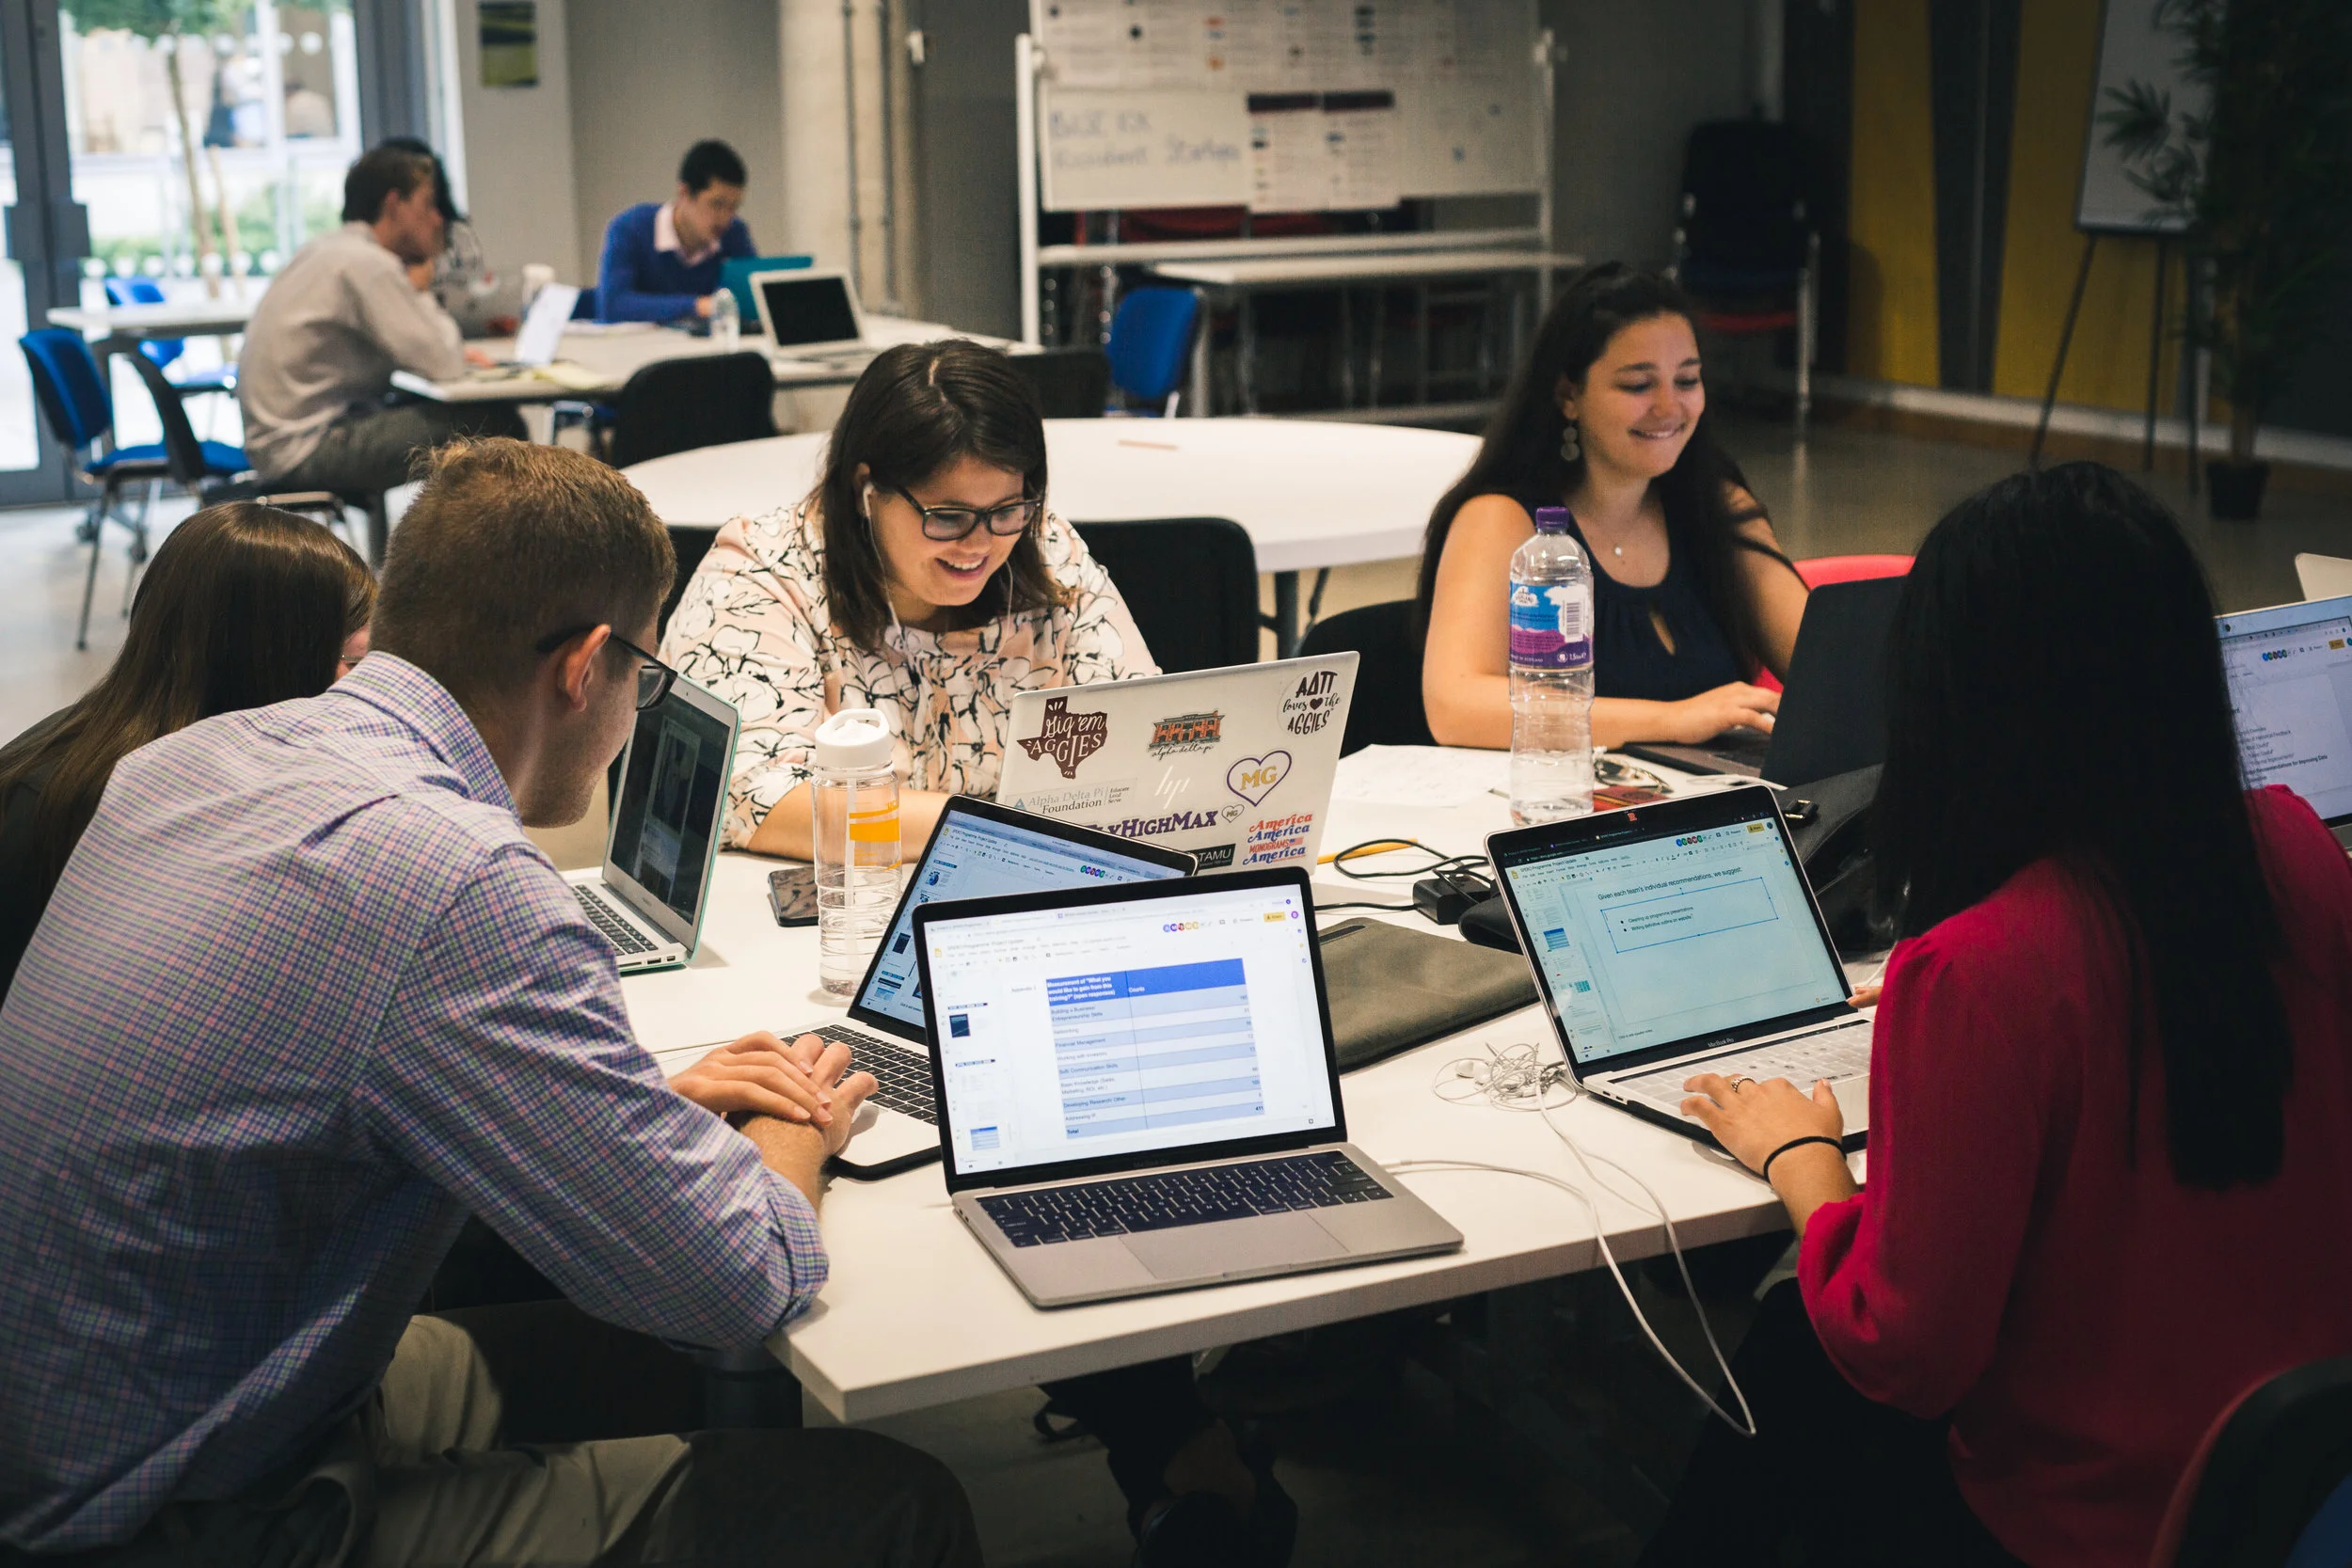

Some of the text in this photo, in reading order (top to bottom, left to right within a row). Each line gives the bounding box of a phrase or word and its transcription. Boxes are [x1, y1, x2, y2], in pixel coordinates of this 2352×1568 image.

[1283, 692, 1341, 712] loves the
[1287, 709, 1330, 735] AGGIES
[1030, 734, 1102, 767] AGGIES
[1240, 766, 1277, 791] MG
[1028, 787, 1104, 808] Alpha Delta Pi
[1041, 798, 1103, 814] Foundation
[1086, 810, 1218, 838] YHIGHMAX
[1249, 813, 1313, 832] America
[1248, 824, 1311, 843] America
[1199, 848, 1232, 863] TAMU
[1249, 838, 1290, 854] MONOGRAMS
[1243, 847, 1306, 865] America
[1597, 891, 1613, 900] Given
[1613, 888, 1626, 897] each
[1627, 886, 1644, 895] team's
[1645, 880, 1668, 891] individual
[1668, 873, 1713, 886] recommendations,
[1076, 1037, 1106, 1047] Management
[1708, 1039, 1726, 1048] MacBook
[1063, 1100, 1089, 1109] Developing
